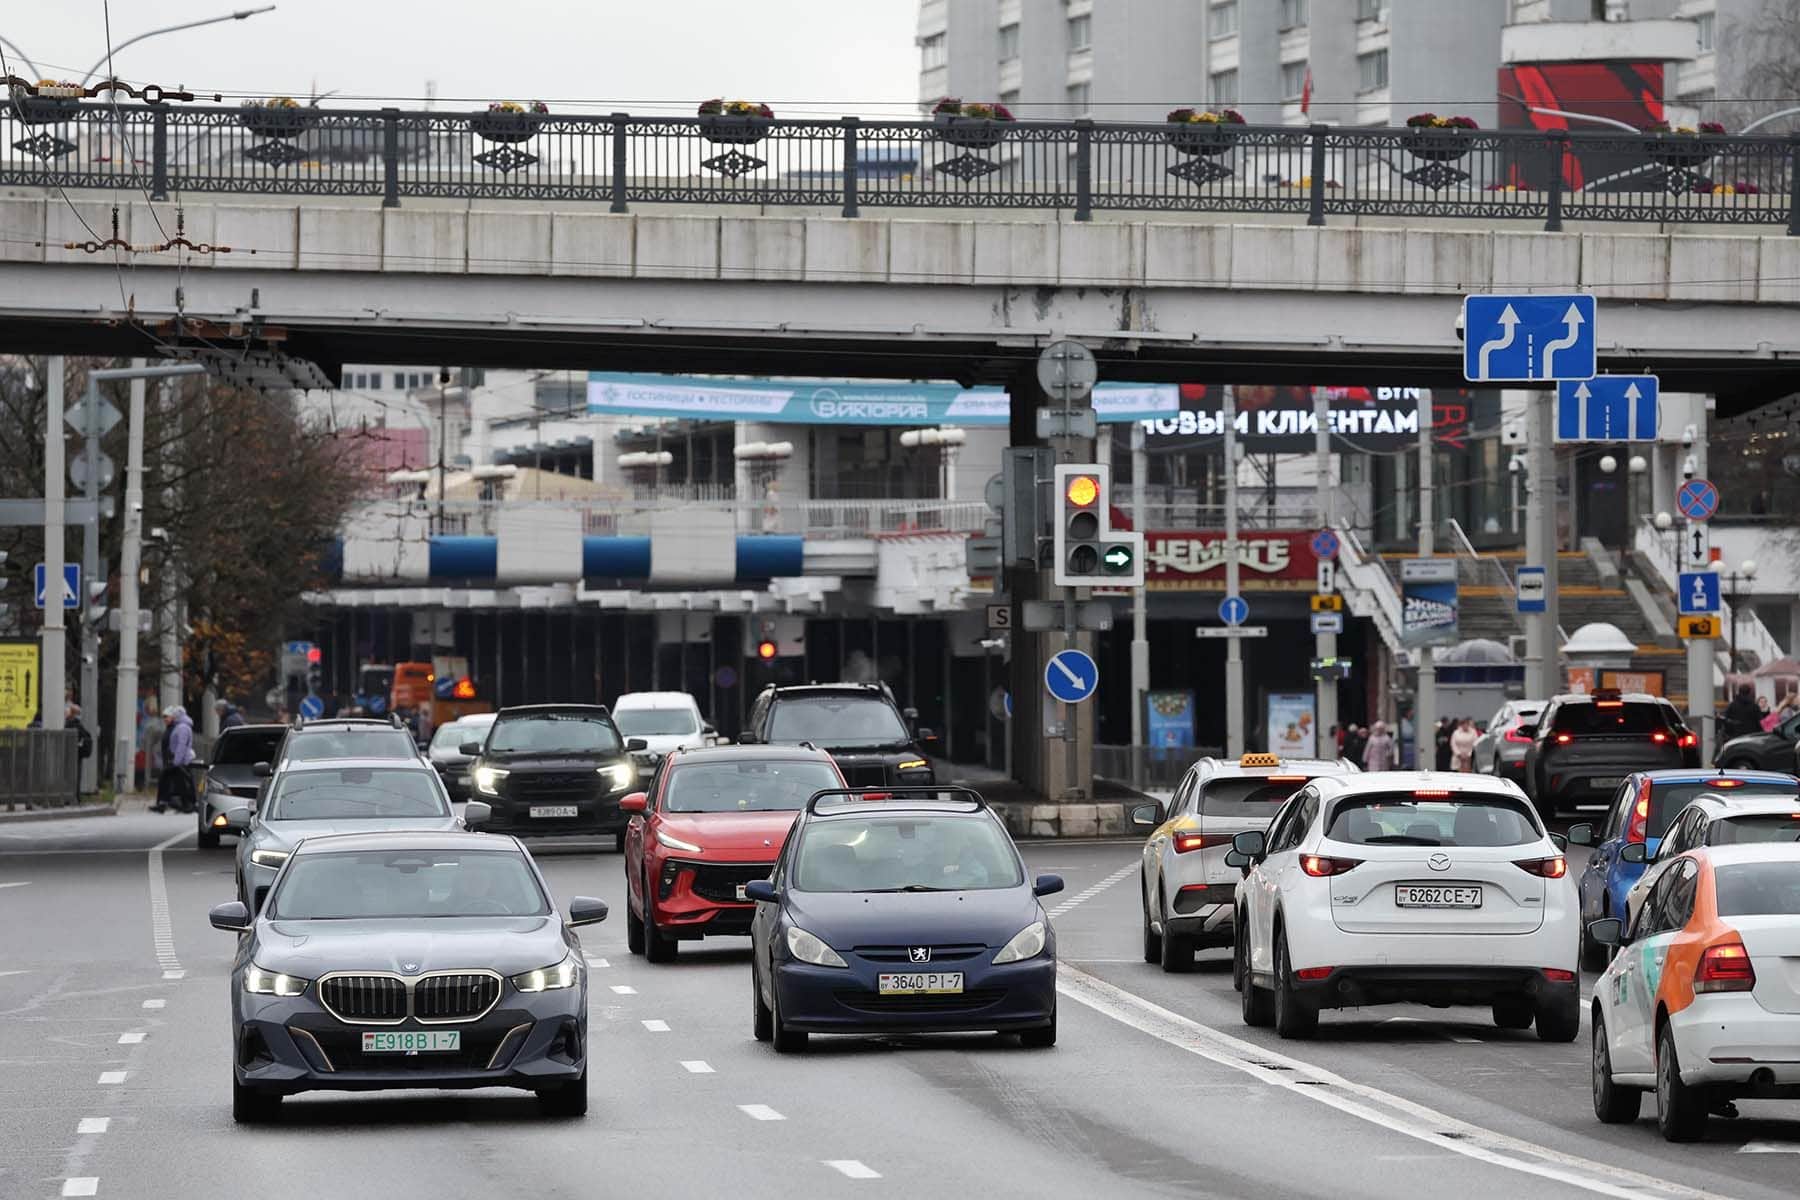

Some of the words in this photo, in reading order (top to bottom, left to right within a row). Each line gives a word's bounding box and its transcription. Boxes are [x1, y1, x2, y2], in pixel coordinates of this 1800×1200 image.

[996, 609, 1008, 625] S
[1409, 889, 1441, 902] 6262
[1444, 889, 1479, 902] CE-7
[892, 976, 923, 989] 3640
